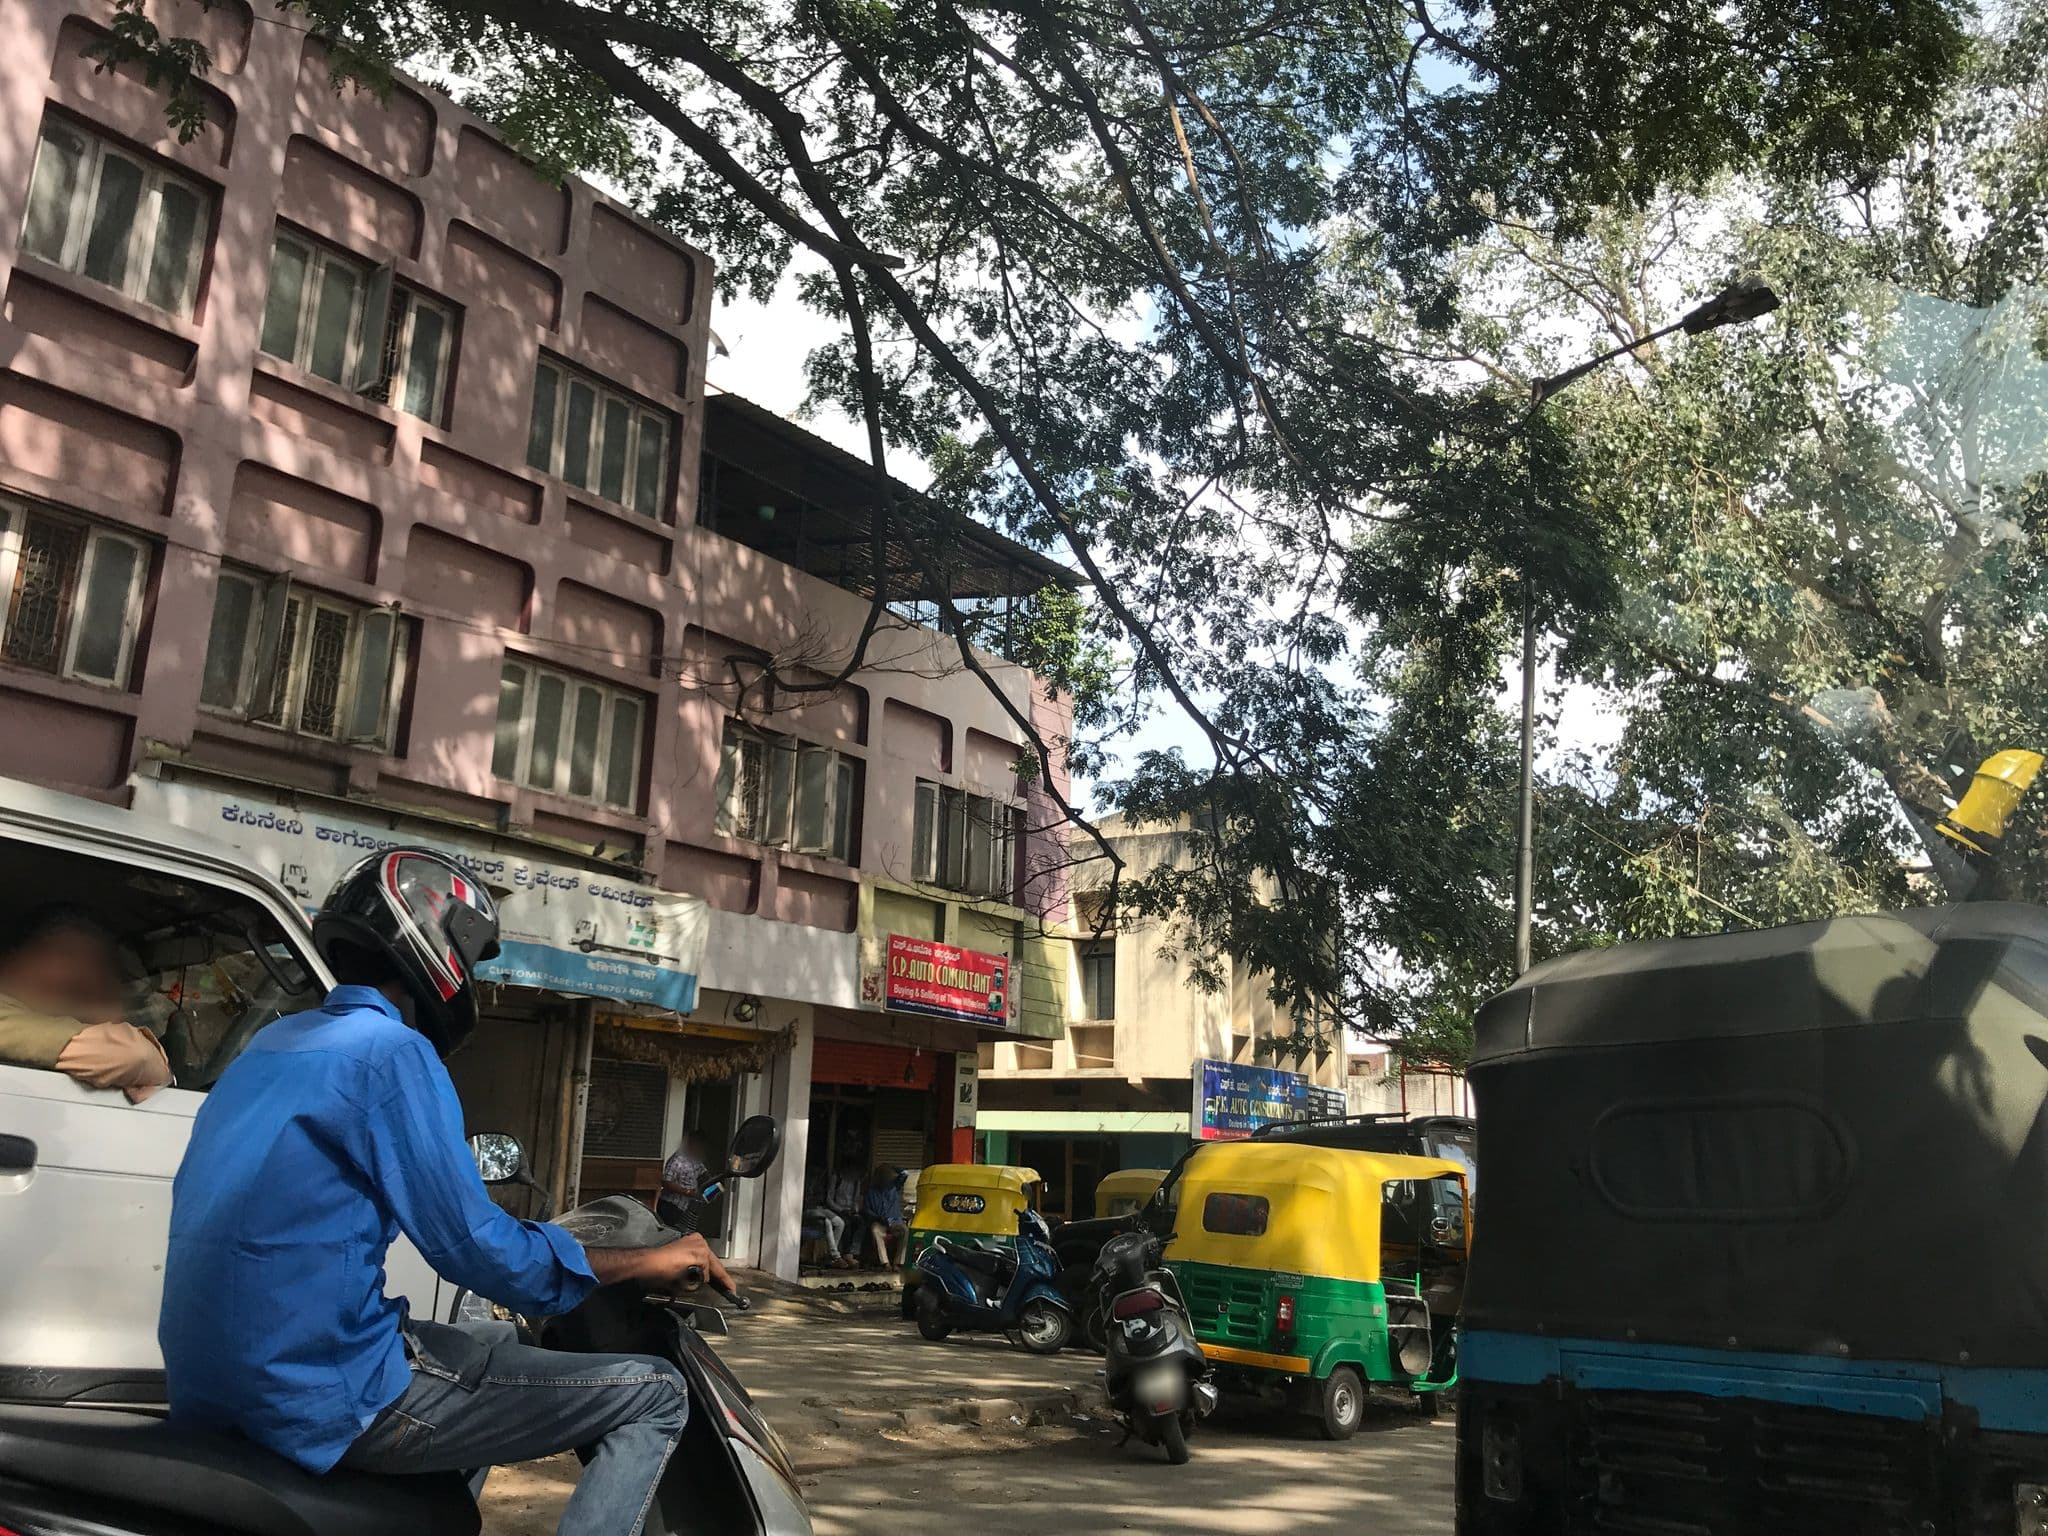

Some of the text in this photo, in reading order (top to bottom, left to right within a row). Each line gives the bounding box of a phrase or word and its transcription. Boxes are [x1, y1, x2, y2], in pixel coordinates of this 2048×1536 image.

[936, 965, 991, 995] CONSULTANT
[893, 983, 914, 999] Buying
[920, 989, 940, 1003] Selling
[1230, 1097, 1248, 1115] AUTO
